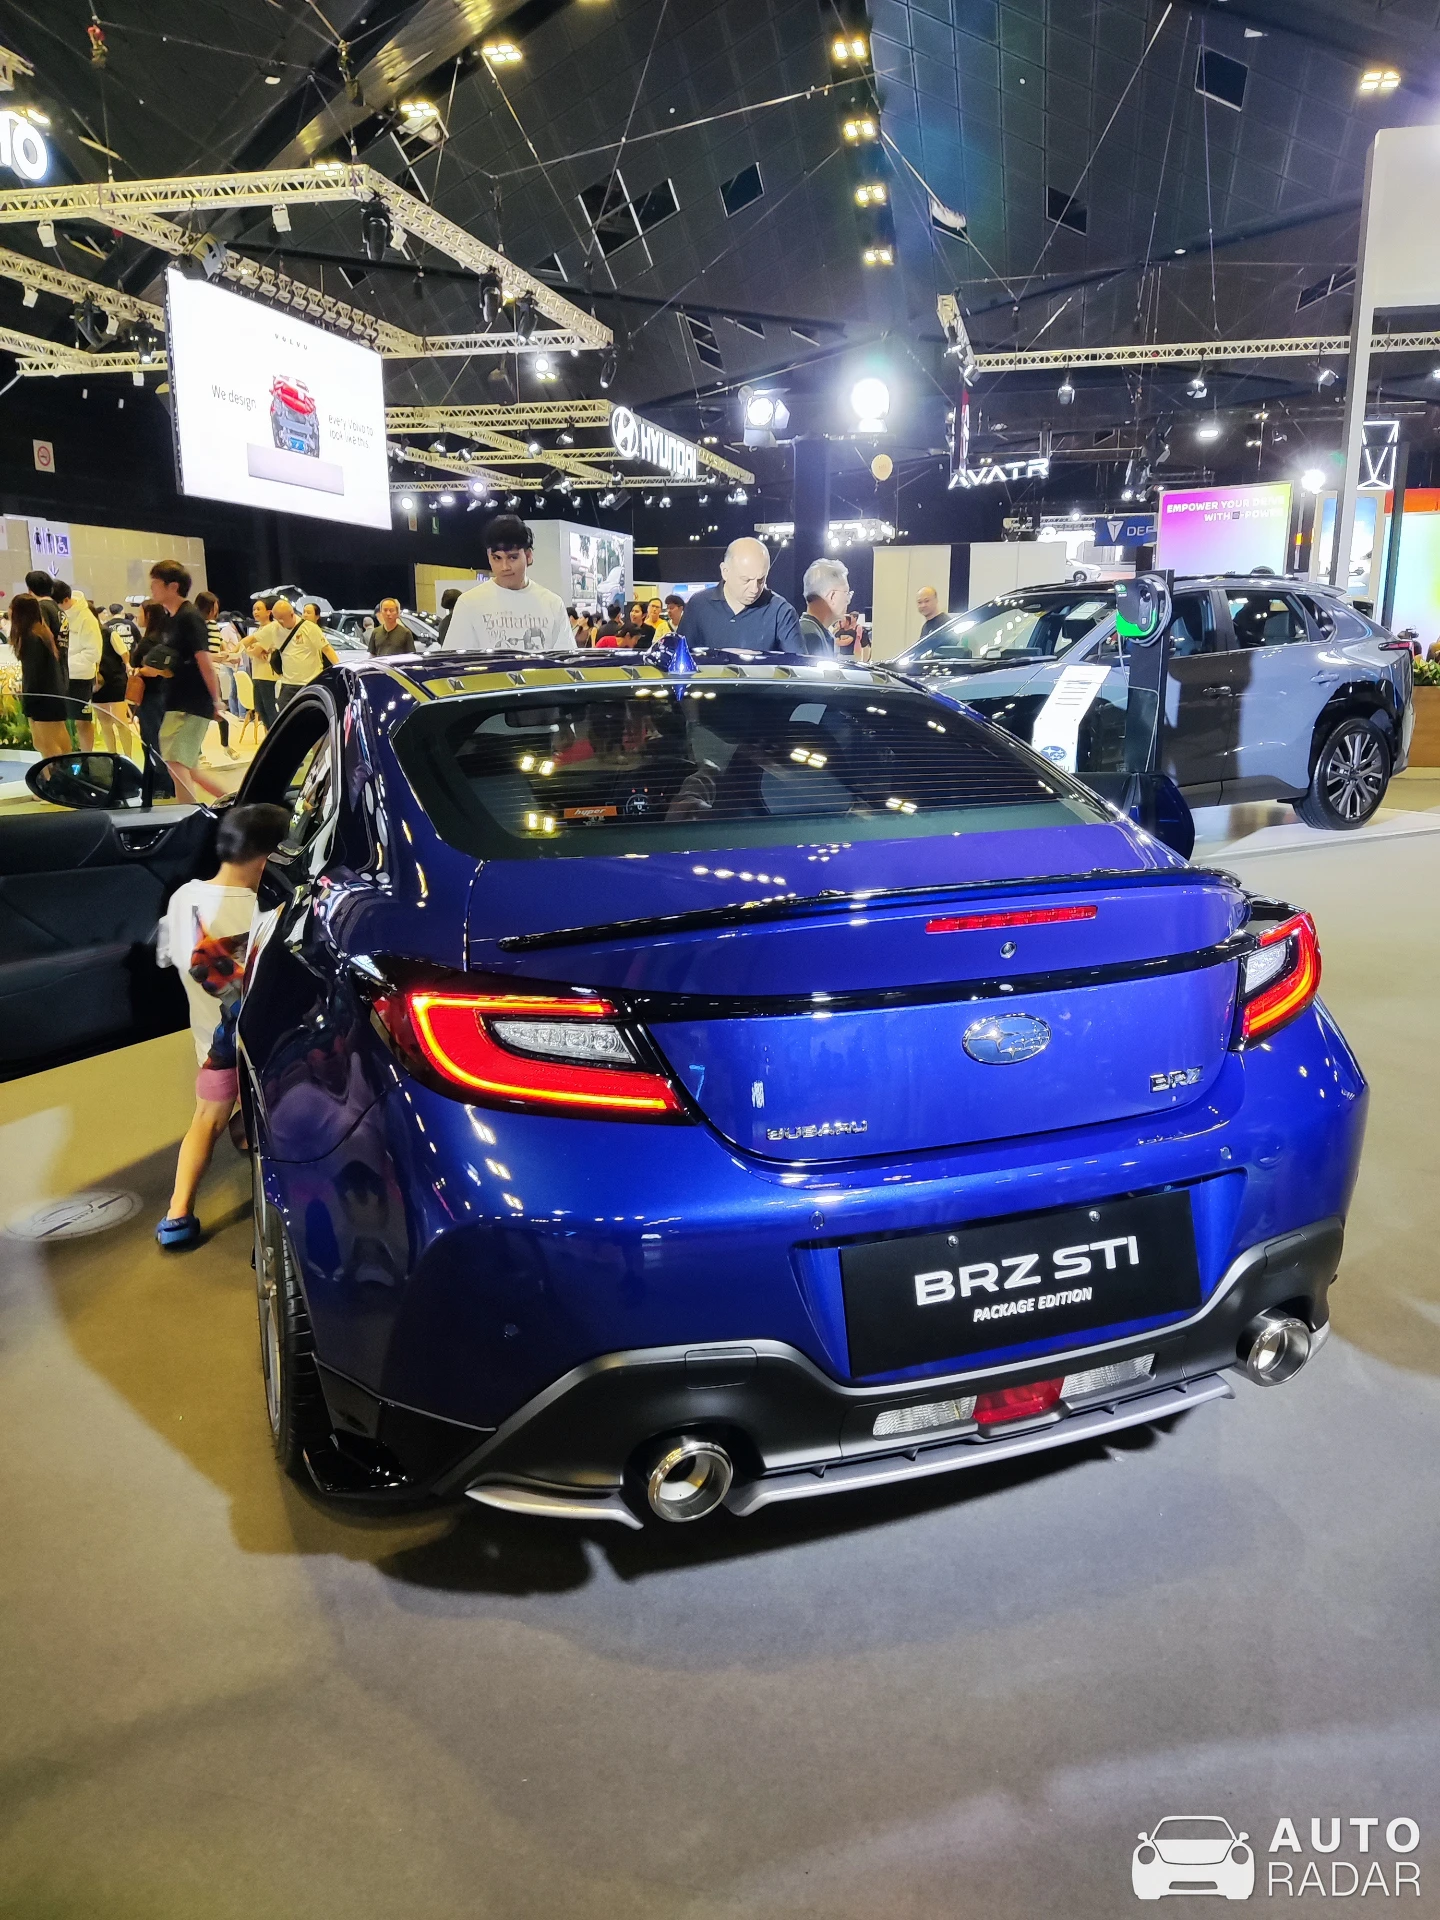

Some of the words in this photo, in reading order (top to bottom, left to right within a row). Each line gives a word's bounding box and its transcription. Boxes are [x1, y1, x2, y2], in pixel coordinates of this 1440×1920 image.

[211, 384, 226, 401] We
[229, 389, 257, 411] design
[640, 423, 697, 480] HYUNDAI
[948, 458, 1050, 490] AVATR
[1166, 501, 1219, 514] EMPOWER
[1220, 498, 1251, 509] YOUR
[1204, 512, 1231, 522] WITH
[574, 808, 607, 816] hyper
[1149, 1066, 1203, 1093] BRZ
[767, 1120, 868, 1140] SUBARU
[914, 1253, 1041, 1306] BRZ
[1052, 1235, 1140, 1280] STI
[973, 1297, 1035, 1323] PACKAGE
[1037, 1286, 1093, 1311] EDITION
